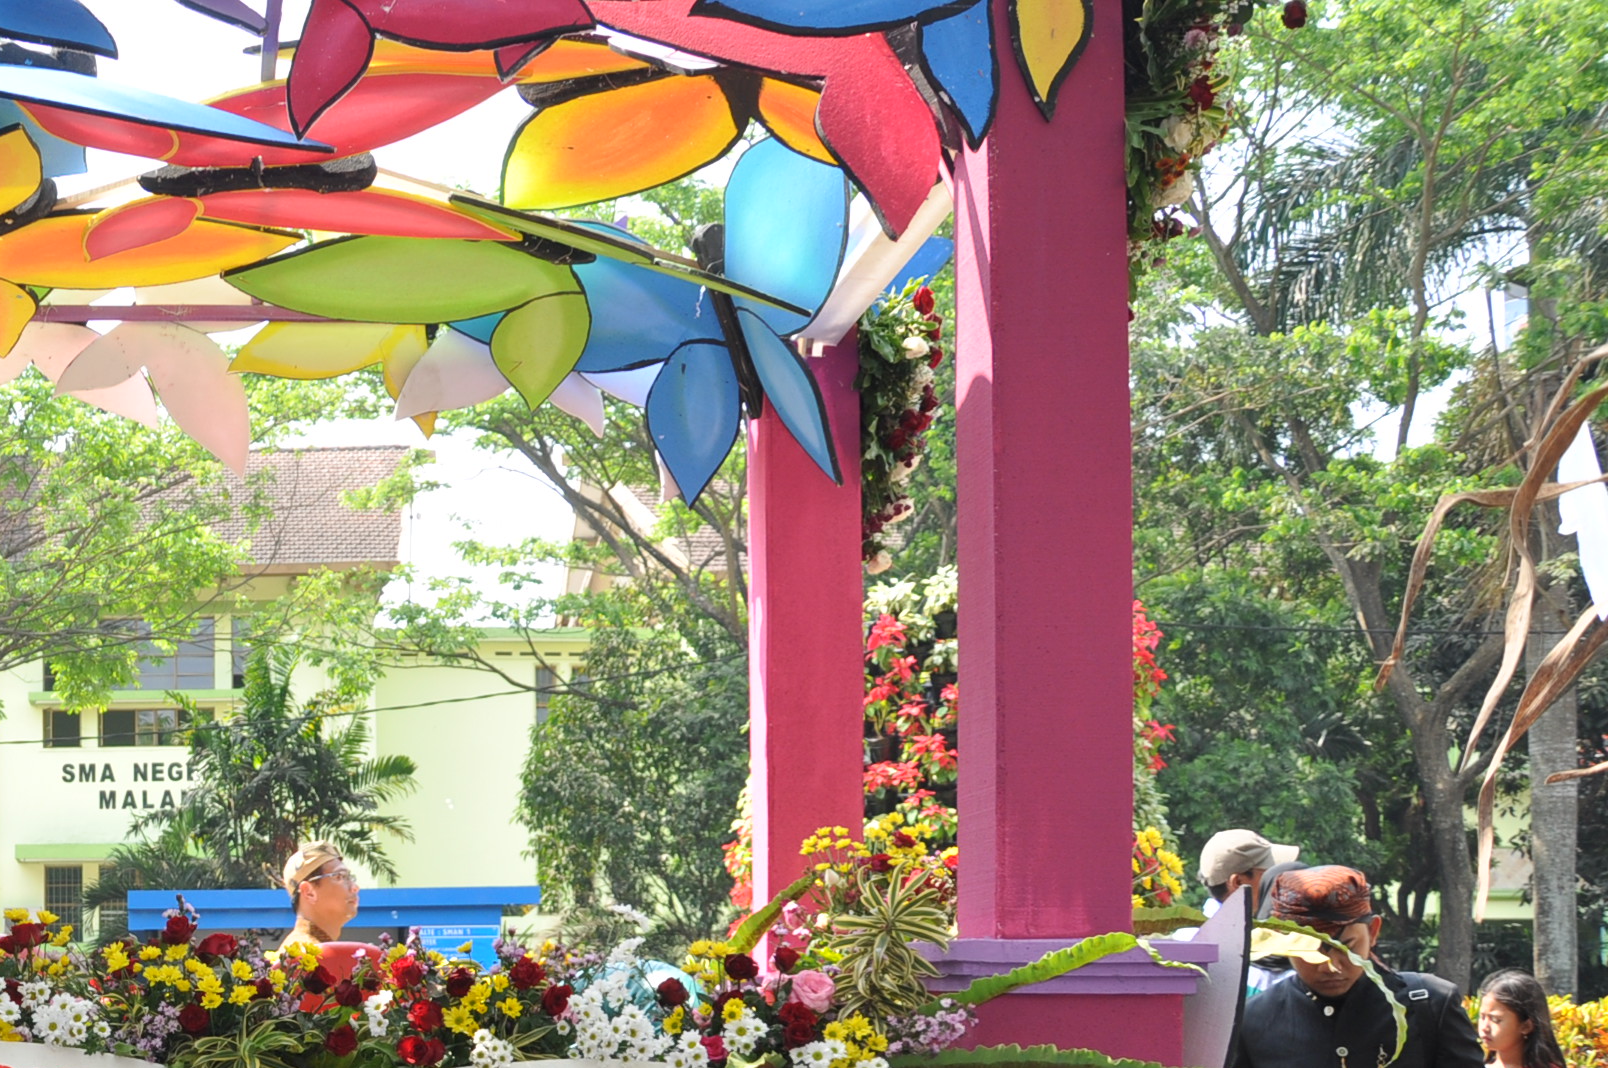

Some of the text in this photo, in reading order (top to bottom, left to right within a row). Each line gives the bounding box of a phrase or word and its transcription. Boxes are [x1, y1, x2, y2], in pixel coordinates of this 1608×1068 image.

[61, 762, 199, 783] SMA NEGE
[98, 790, 190, 810] MALA
